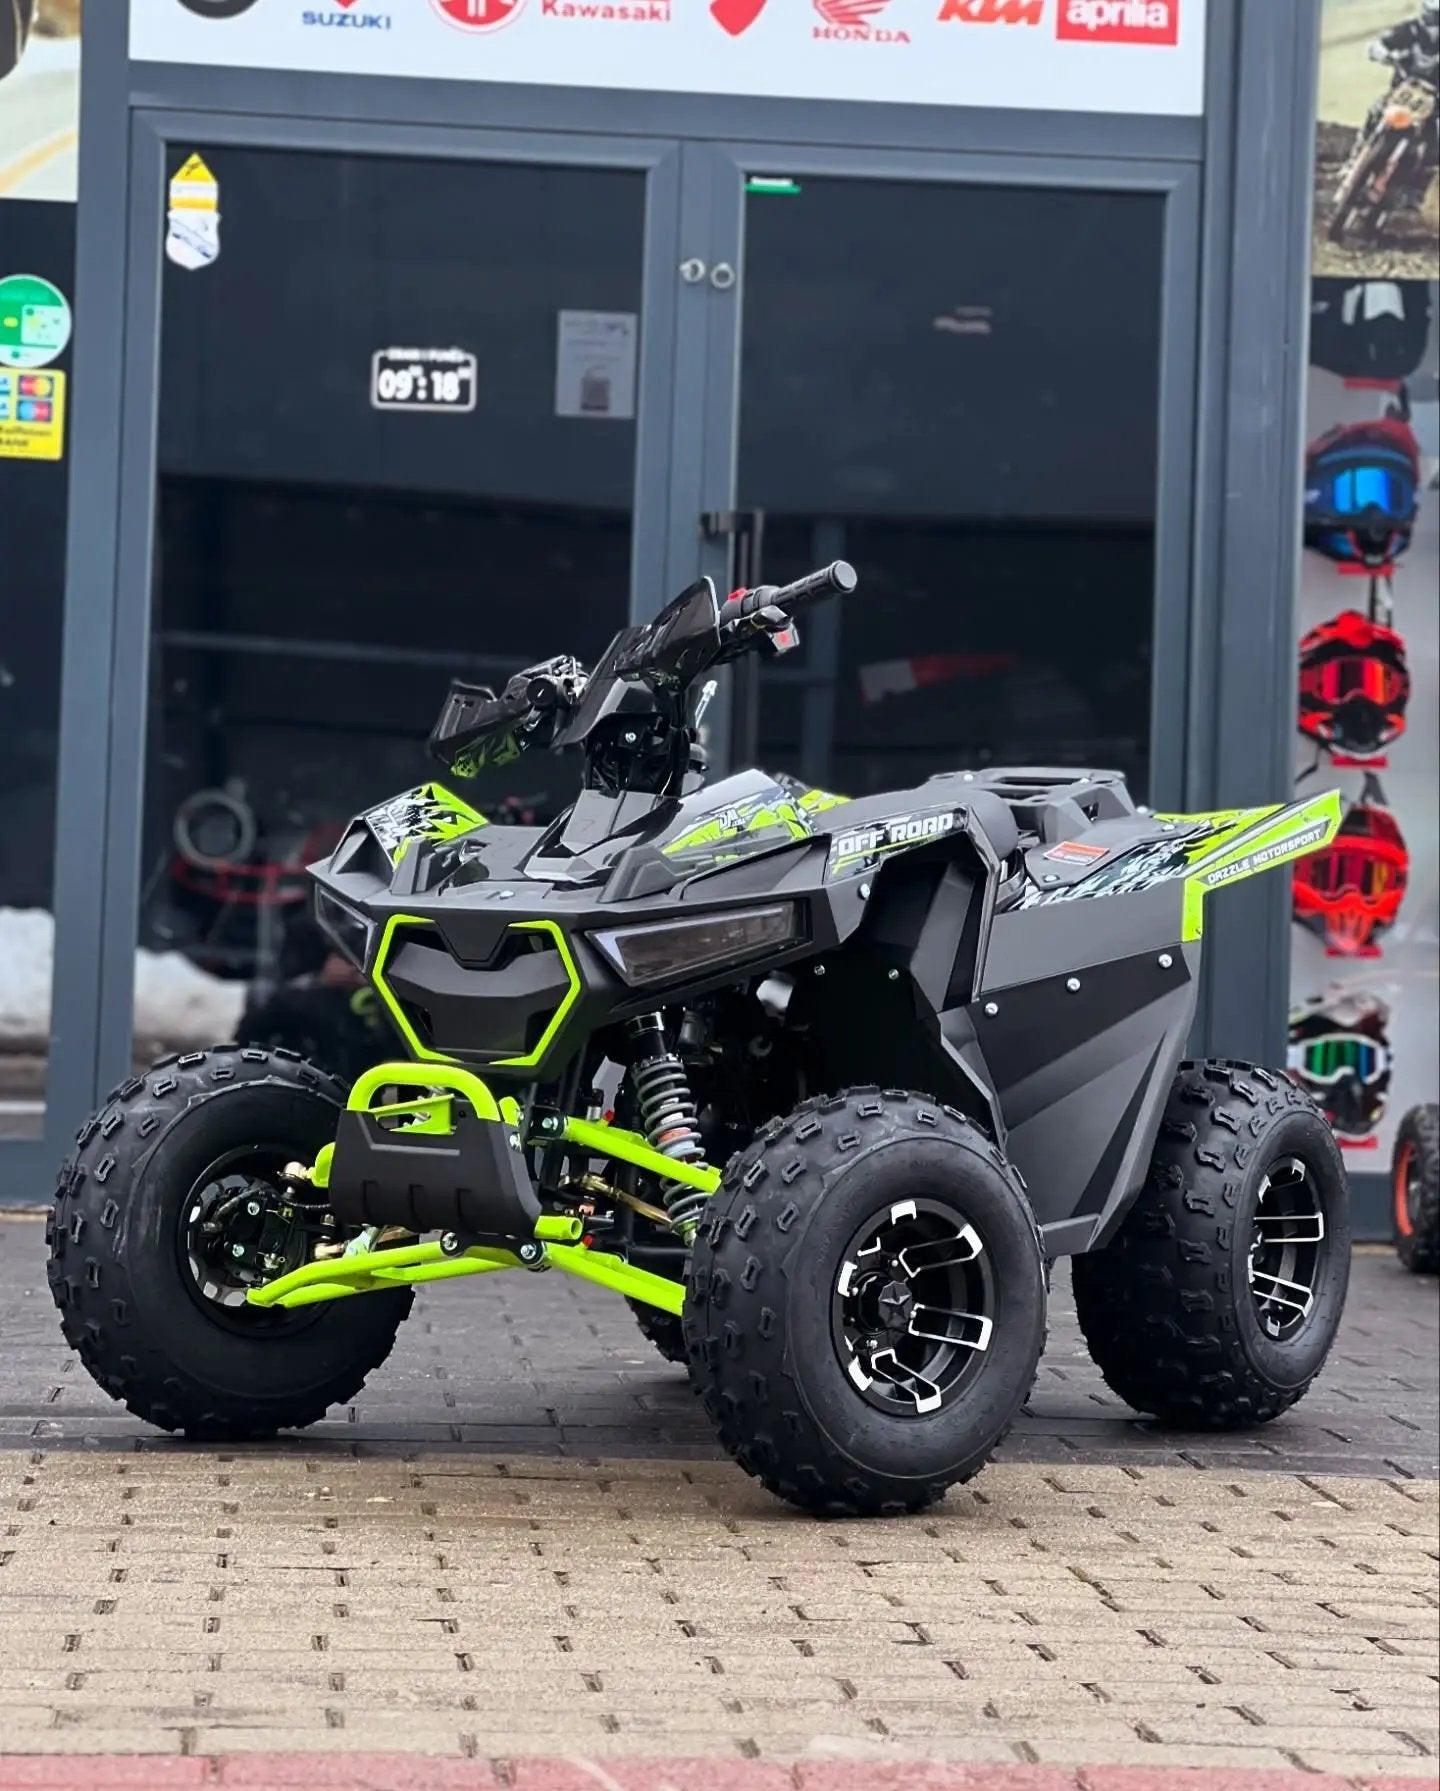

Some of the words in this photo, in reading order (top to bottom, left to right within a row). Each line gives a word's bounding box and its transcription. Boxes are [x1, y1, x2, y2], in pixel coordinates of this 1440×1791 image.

[302, 10, 392, 30] SUZUKI
[541, 0, 671, 22] Kawasaki
[812, 26, 911, 43] HONDA
[837, 827, 885, 857] OFF
[890, 812, 954, 843] ROAD
[1252, 829, 1321, 865] MOTORSPORT
